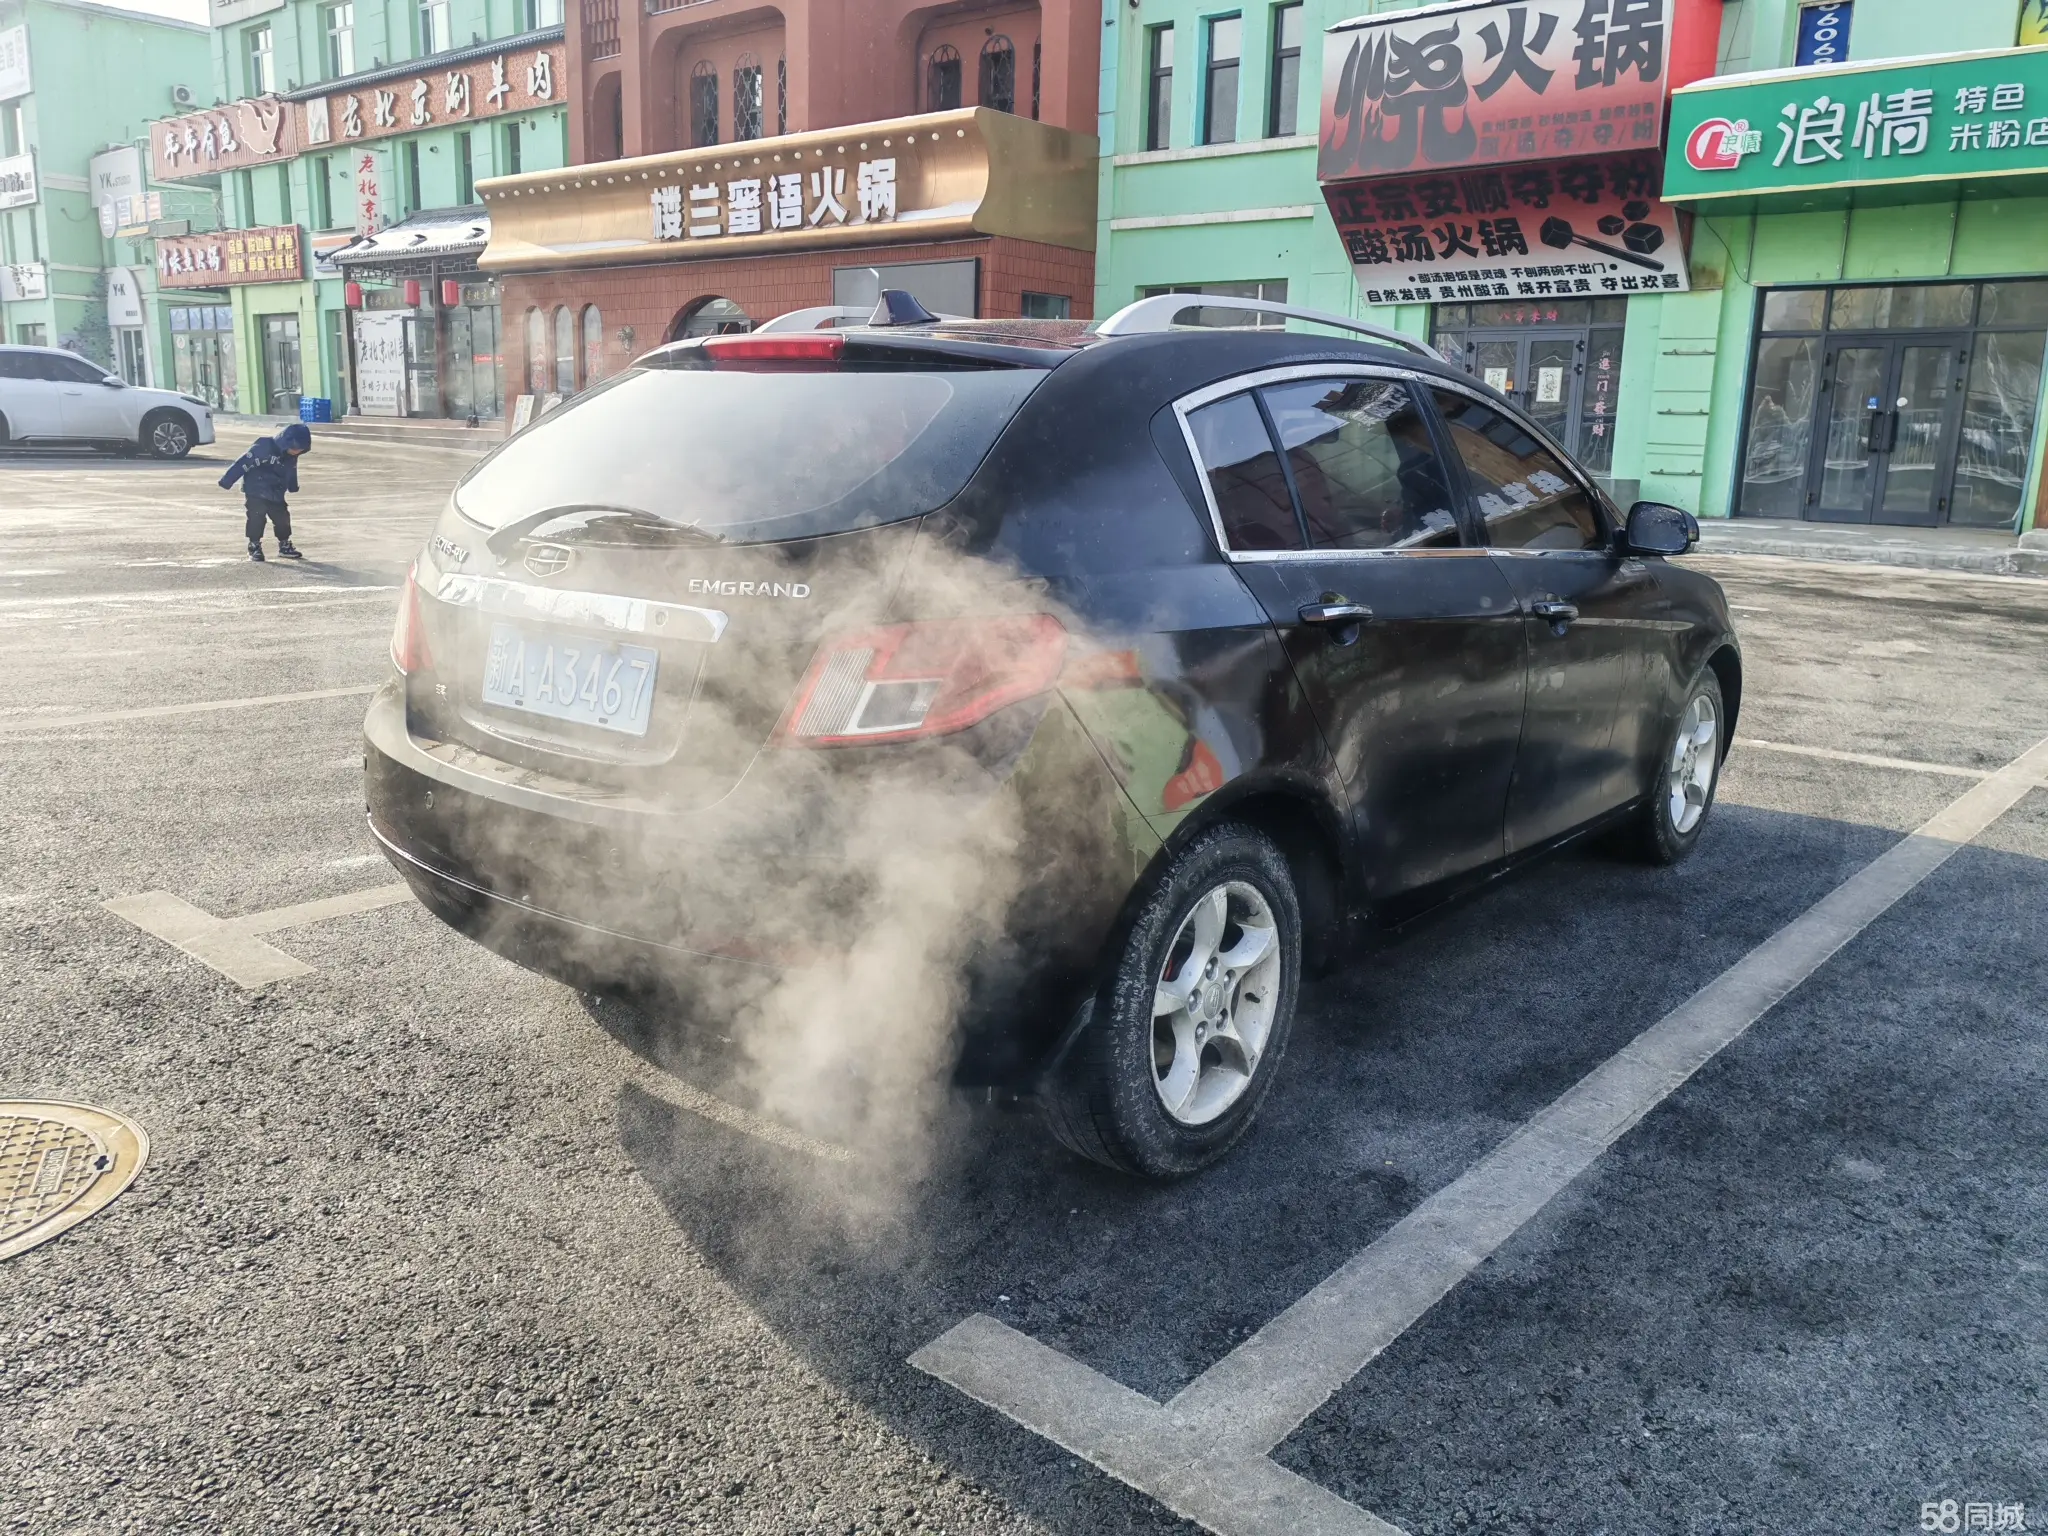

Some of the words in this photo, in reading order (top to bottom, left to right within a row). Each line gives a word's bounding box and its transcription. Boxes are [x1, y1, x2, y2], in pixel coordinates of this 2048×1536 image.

[1954, 82, 2025, 115] 特色
[1772, 88, 1934, 168] 浪情
[1948, 117, 2048, 151] 米粉店
[650, 157, 897, 240] 楼兰蜜语火锅
[1338, 157, 1660, 226] 正宗安顺夺夺粉
[1344, 216, 1529, 265] 酸汤火锅
[1366, 286, 1432, 303] 自然发酵
[1439, 282, 1509, 299] 贵州酸汤
[1517, 278, 1591, 296] 烧开富贵
[1601, 273, 1681, 292] 夺出欢喜
[1417, 266, 1507, 284] 酸汤泡饭是灵魂
[1510, 262, 1606, 279] 不刨两碗不出门
[688, 578, 811, 599] EMGRAND
